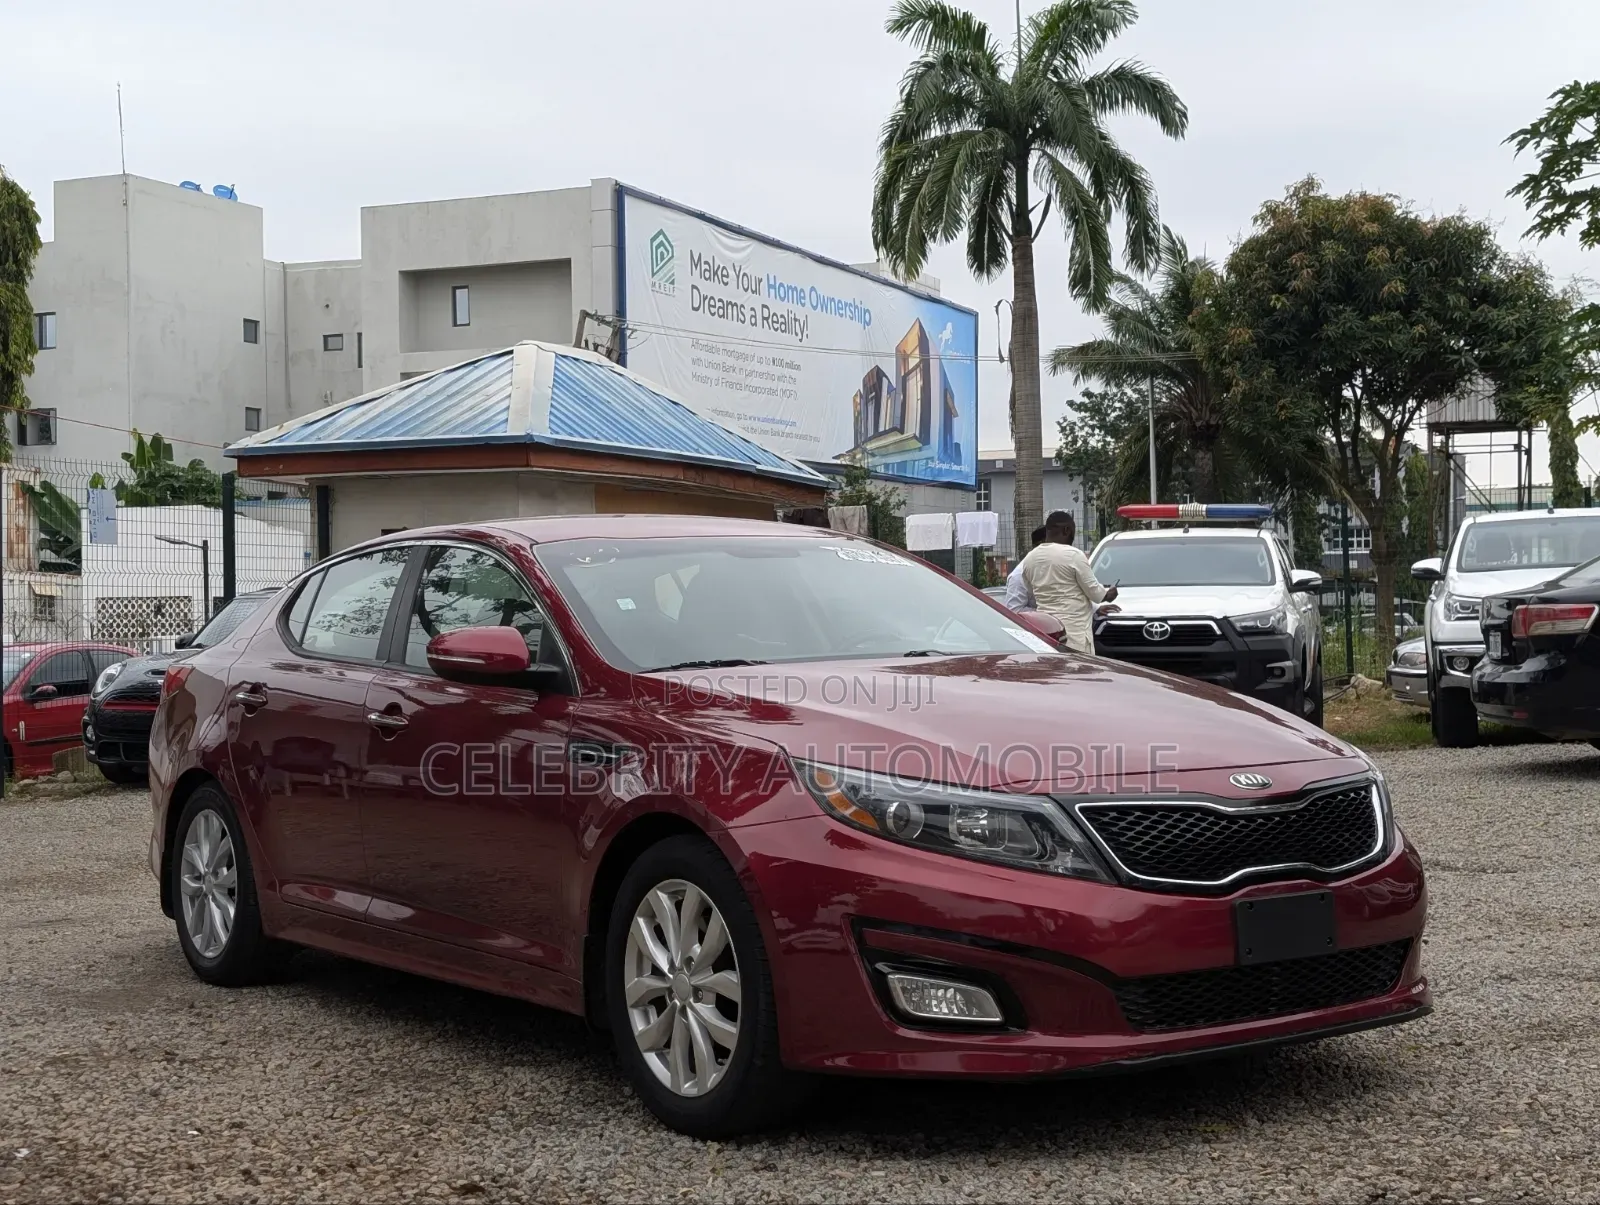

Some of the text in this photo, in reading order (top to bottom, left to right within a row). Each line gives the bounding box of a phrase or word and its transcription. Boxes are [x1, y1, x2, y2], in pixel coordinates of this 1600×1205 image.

[689, 249, 872, 331] Make Your Home Ownership
[690, 283, 809, 343] Dreams a Reality!
[691, 338, 720, 356] Affordable
[722, 348, 749, 363] mortgage
[750, 352, 756, 363] of
[757, 356, 764, 366] up
[765, 356, 771, 366] to
[785, 360, 802, 371] million
[691, 356, 704, 368] with
[704, 358, 720, 371] Union
[739, 366, 744, 376] in
[745, 369, 776, 383] partnership
[788, 374, 797, 386] the
[691, 371, 713, 388] Ministry
[714, 376, 720, 387] of
[721, 377, 743, 392] Finance
[744, 381, 779, 397] Incorporated
[1234, 773, 1270, 786] KIA
